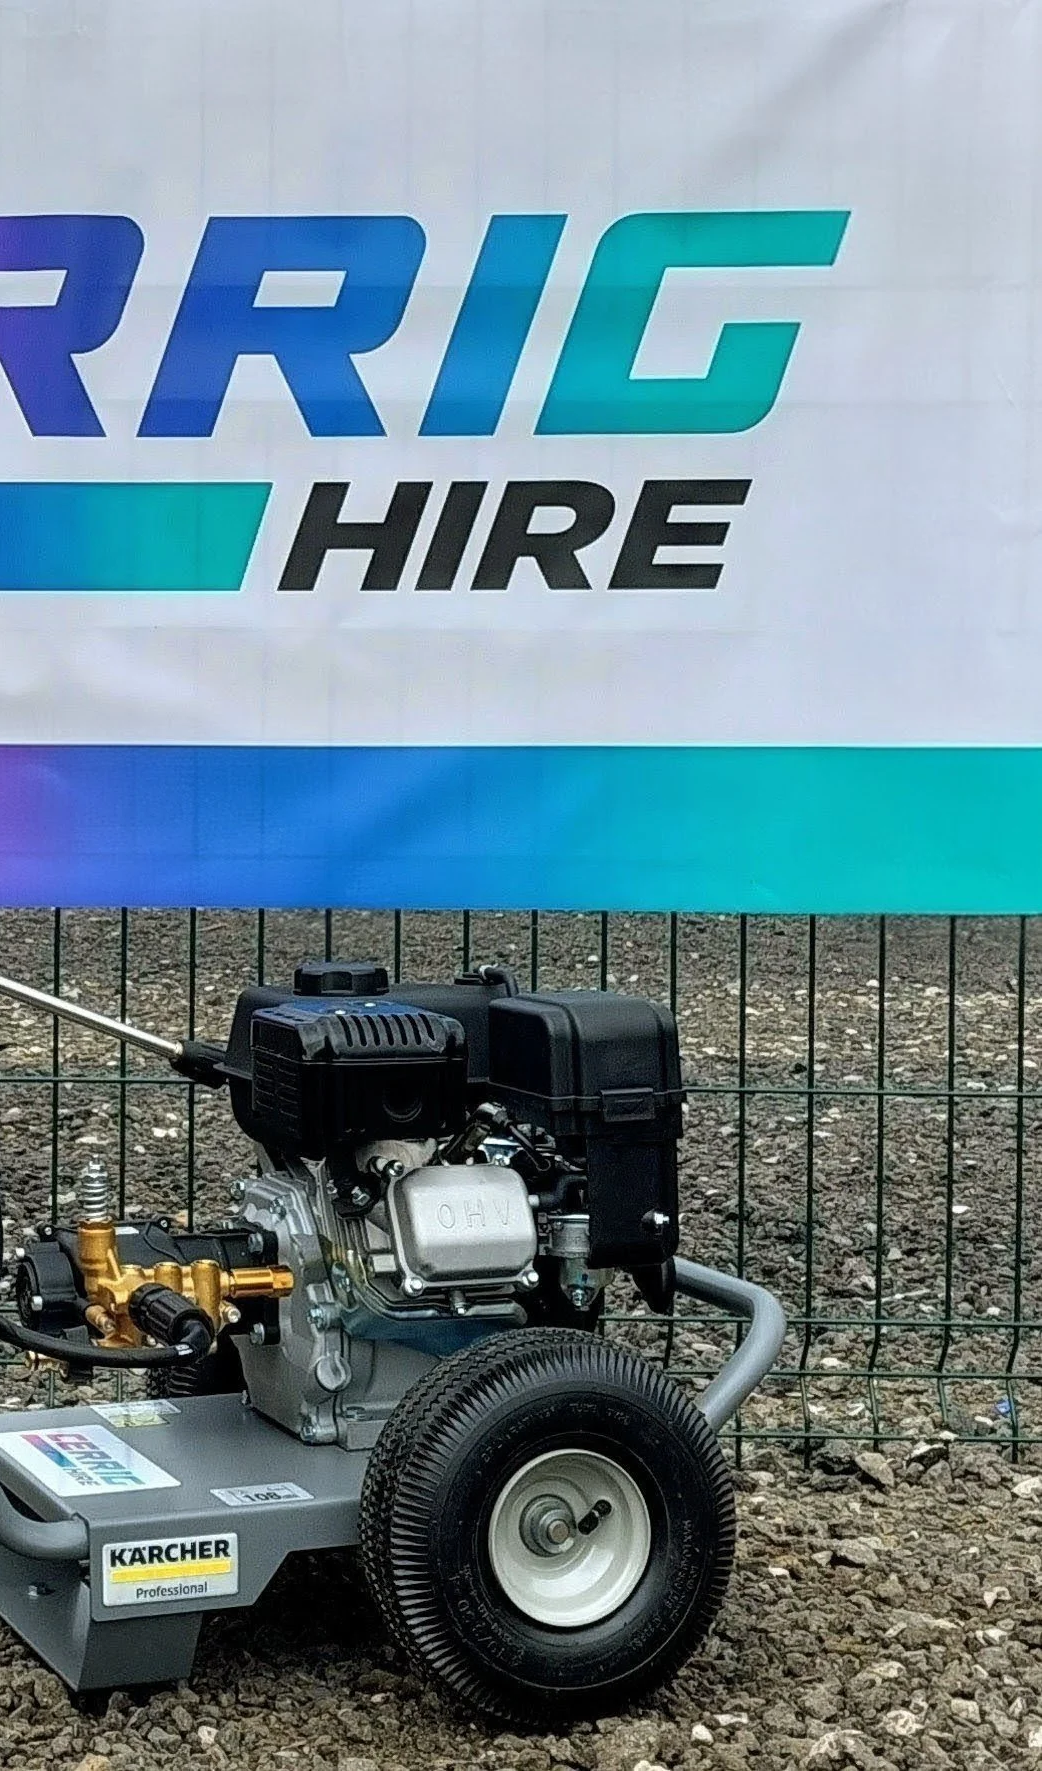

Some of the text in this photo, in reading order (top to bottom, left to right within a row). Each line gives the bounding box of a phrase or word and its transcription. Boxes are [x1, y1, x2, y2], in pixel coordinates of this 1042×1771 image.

[277, 479, 753, 591] HIRE
[438, 1199, 510, 1229] OHV
[46, 1433, 146, 1486] CERRIG
[245, 1492, 281, 1502] 108
[110, 1539, 231, 1568] KÄRCHER
[136, 1581, 208, 1599] Professional
